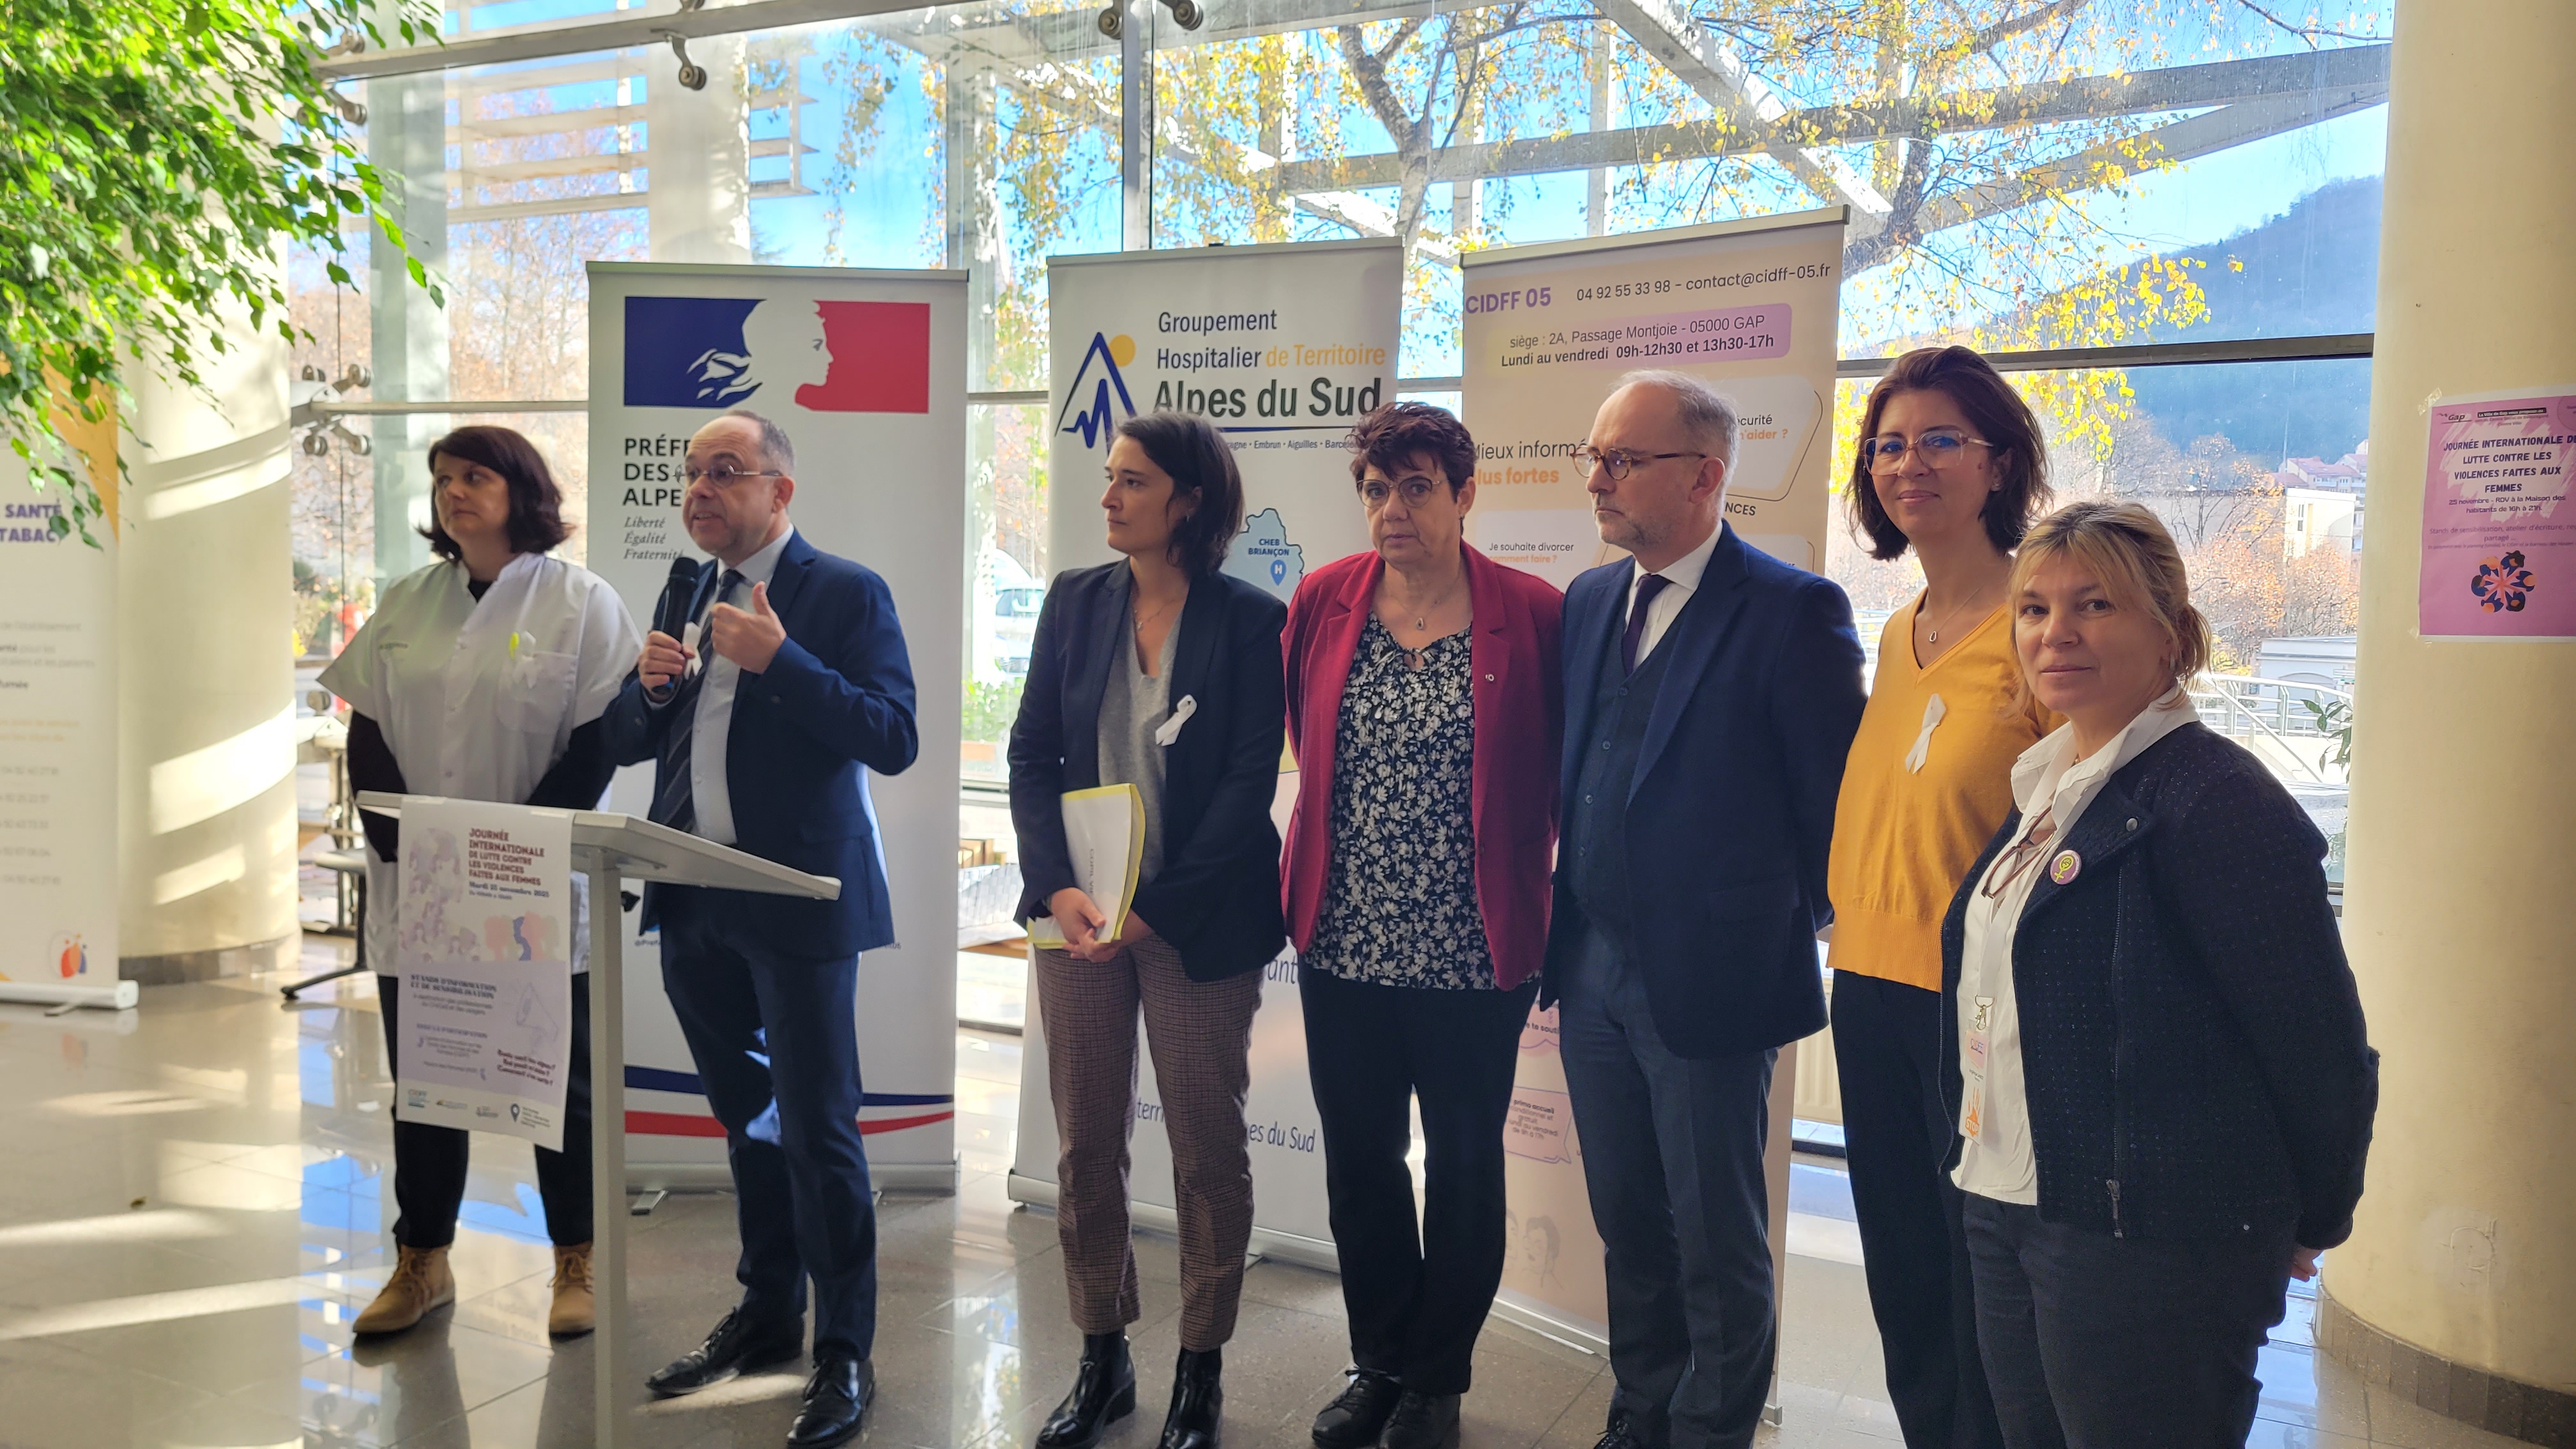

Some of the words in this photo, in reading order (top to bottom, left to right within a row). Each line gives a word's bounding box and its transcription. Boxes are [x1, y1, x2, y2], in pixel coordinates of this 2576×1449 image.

[1577, 289, 1592, 301] 04
[1597, 286, 1611, 298] 92
[1615, 284, 1631, 297] 55
[1635, 282, 1650, 295] 33
[1654, 280, 1671, 293] 98
[1685, 263, 1831, 291] contact@cidff-05.fr
[1465, 290, 1521, 314] CIDFF
[1526, 287, 1551, 307] 05
[1158, 309, 1277, 337] Groupement
[1510, 334, 1538, 349] siège
[1549, 332, 1567, 346] 2A,
[1572, 330, 1622, 343] Passage
[1626, 322, 1677, 340] Montjoie
[1690, 318, 1729, 334] 05000
[1733, 315, 1765, 330] GAP
[1157, 346, 1262, 373] Hospitalier
[1266, 346, 1289, 368] de
[1293, 342, 1386, 367] Territoire
[1501, 352, 1533, 367] Lundi
[1537, 355, 1551, 364] au
[1555, 346, 1609, 362] vendredi
[1616, 341, 1682, 358] 09h-12h30
[1686, 340, 1699, 353] et
[1703, 334, 1774, 352] 13h30-17h
[1153, 379, 1246, 418] Alpes
[1257, 378, 1298, 418] du
[1308, 376, 1382, 417] Sud
[2448, 414, 2465, 423] Gap
[1782, 429, 1788, 439] ?
[1254, 440, 1282, 448] Embrun
[1287, 440, 1318, 450] Aiguilles
[2443, 438, 2480, 451] JOURNÉE
[2481, 435, 2564, 448] INTERNATIONALE
[2463, 455, 2490, 464] LUTTE
[2493, 452, 2529, 463] CONTRE
[2533, 452, 2552, 460] LES
[624, 463, 670, 482] DES
[1477, 468, 1503, 485] lus
[1506, 467, 1560, 484] fortes
[2454, 468, 2499, 480] VIOLENCES
[2503, 467, 2536, 477] FAITES
[2540, 466, 2562, 475] AUX
[2485, 483, 2522, 493] FEMMES
[623, 487, 682, 507] ALPE
[5, 498, 63, 519] SANTÉ
[1725, 502, 1756, 516] NCES
[624, 516, 666, 529] Liberté
[624, 531, 666, 546] Égalité
[1248, 548, 1290, 557] BRIANÇON
[1489, 543, 1498, 551] Je
[1501, 542, 1536, 551] souhaite
[1538, 542, 1574, 551] divorcer
[1531, 555, 1551, 563] faire
[1552, 555, 1558, 563] ?
[469, 828, 509, 841] JOURNÉE
[469, 839, 544, 857] INTERNATIONALE
[469, 850, 478, 859] DE
[480, 852, 500, 861] LUTTE
[502, 855, 532, 865] CONTRE
[469, 860, 481, 868] LES
[482, 862, 525, 874] VIOLENCES
[469, 869, 493, 879] FAITES
[495, 873, 510, 882] AUX
[512, 875, 541, 886] FEMMES
[1268, 1121, 1286, 1146] du
[1289, 1126, 1316, 1153] Sud
